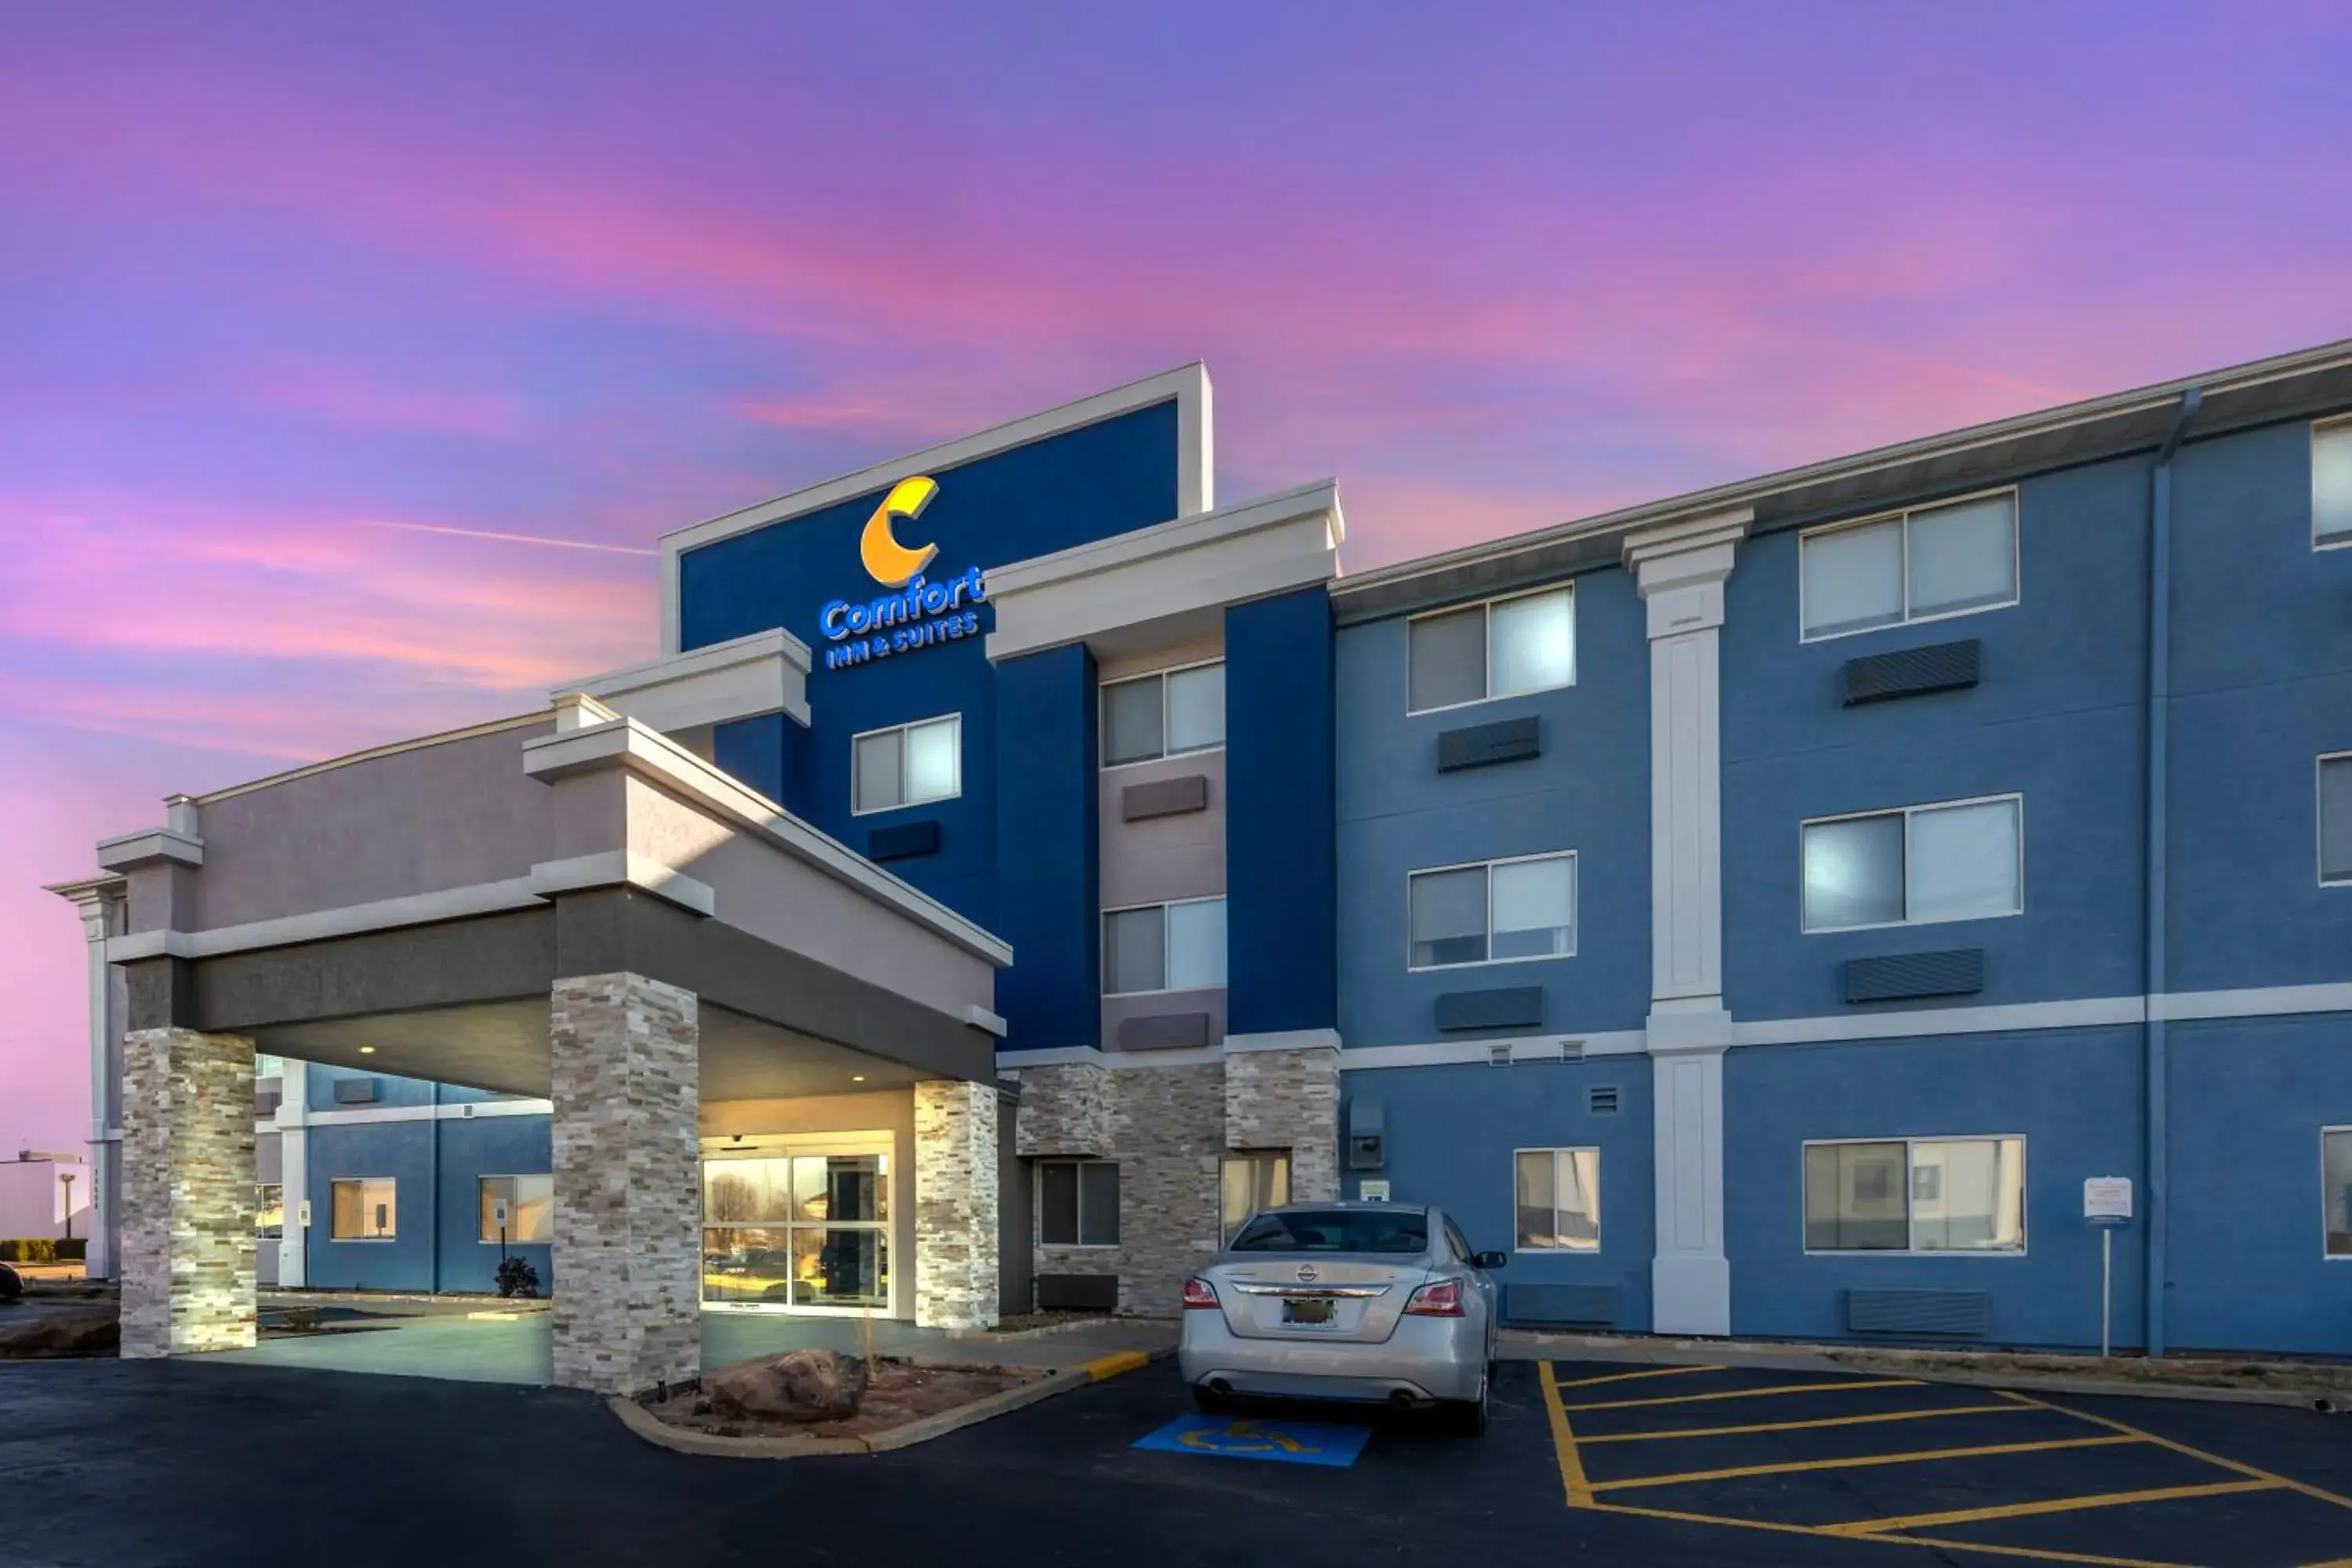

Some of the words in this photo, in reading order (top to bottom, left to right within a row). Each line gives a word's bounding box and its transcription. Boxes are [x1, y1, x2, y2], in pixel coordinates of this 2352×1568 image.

[821, 566, 987, 641] Comfort
[826, 641, 870, 670] INN
[873, 636, 891, 658] &
[892, 612, 979, 653] SUITES
